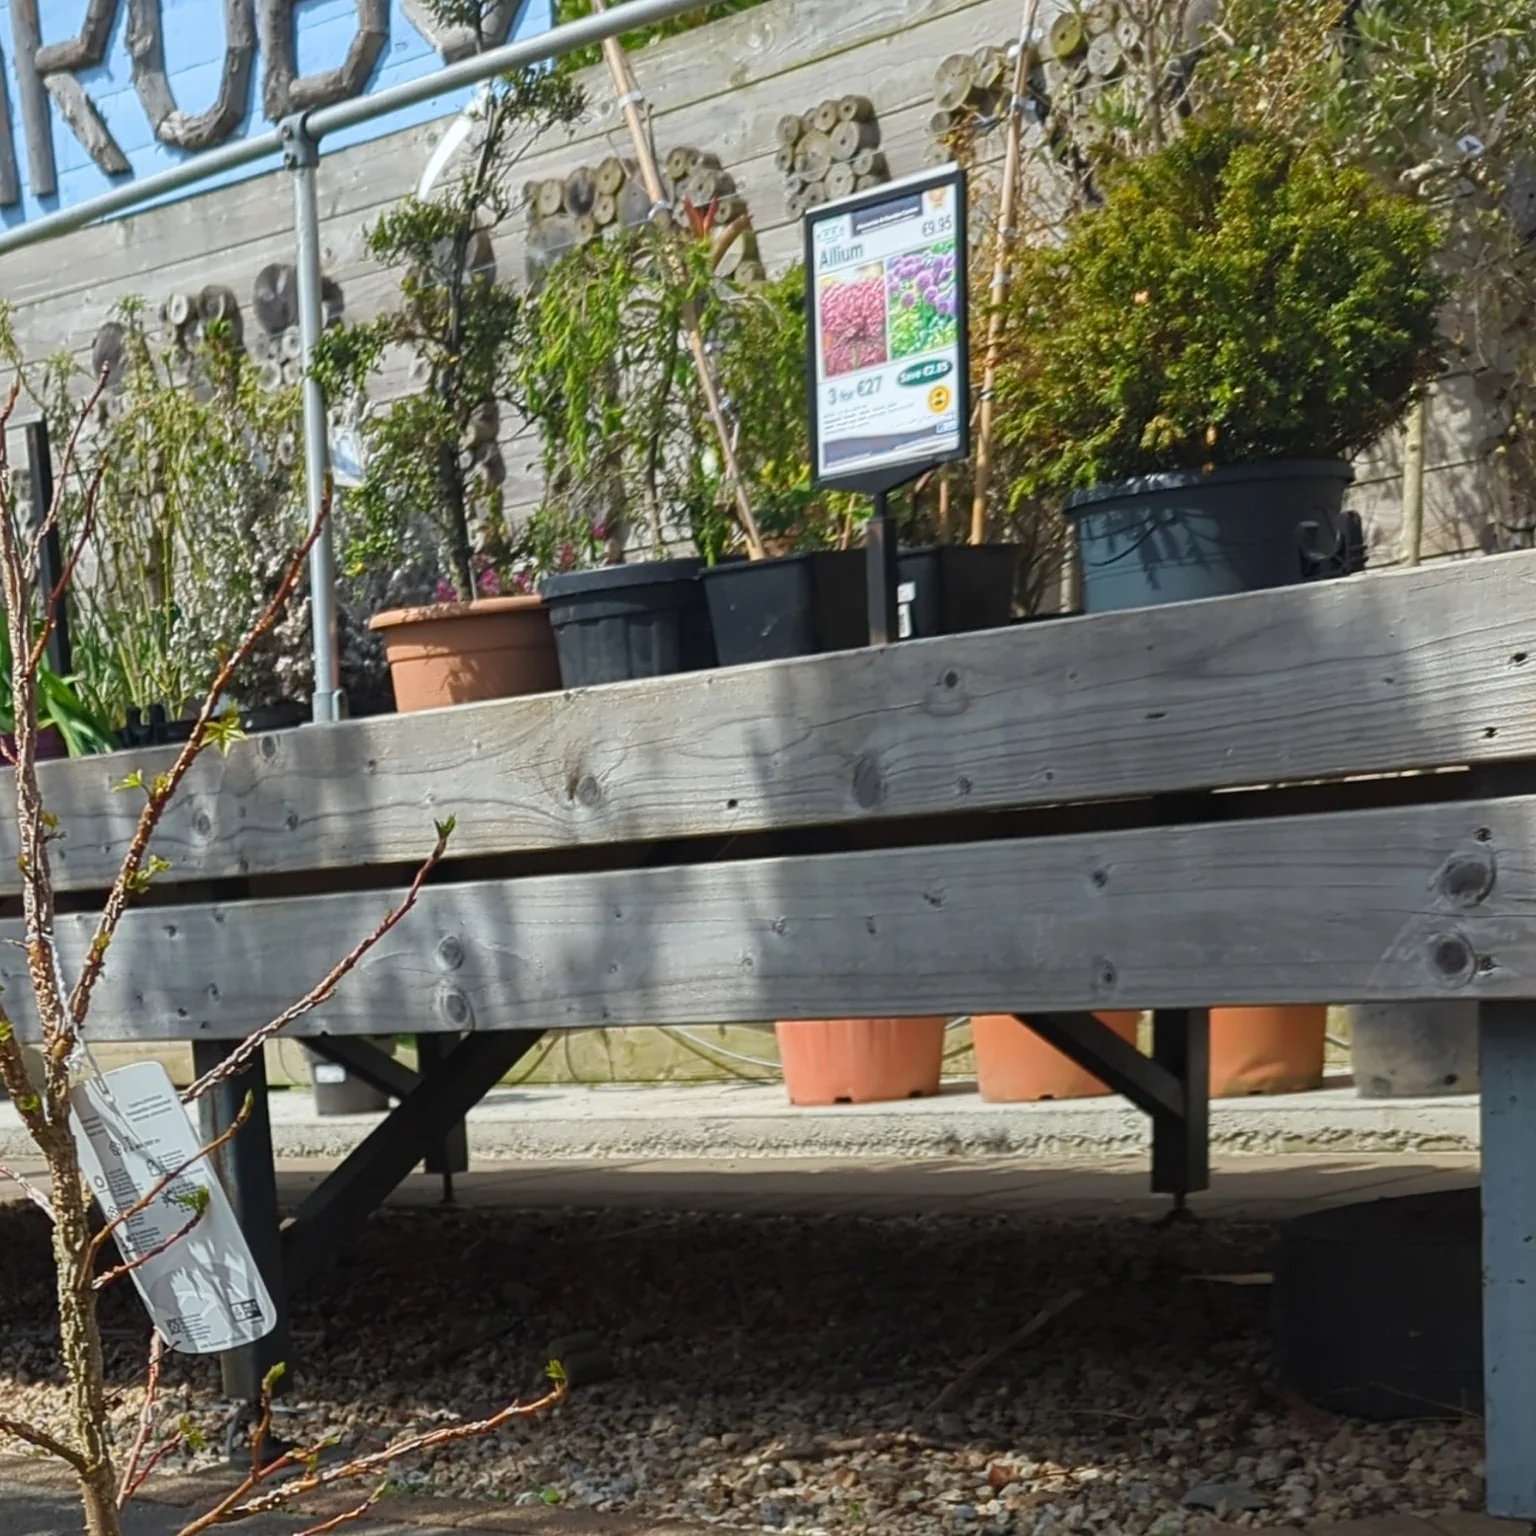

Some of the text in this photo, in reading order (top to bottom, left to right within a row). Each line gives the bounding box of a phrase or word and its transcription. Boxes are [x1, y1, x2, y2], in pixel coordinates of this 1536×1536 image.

[819, 244, 864, 270] Allium
[827, 388, 836, 405] 3
[856, 375, 882, 397] €27
